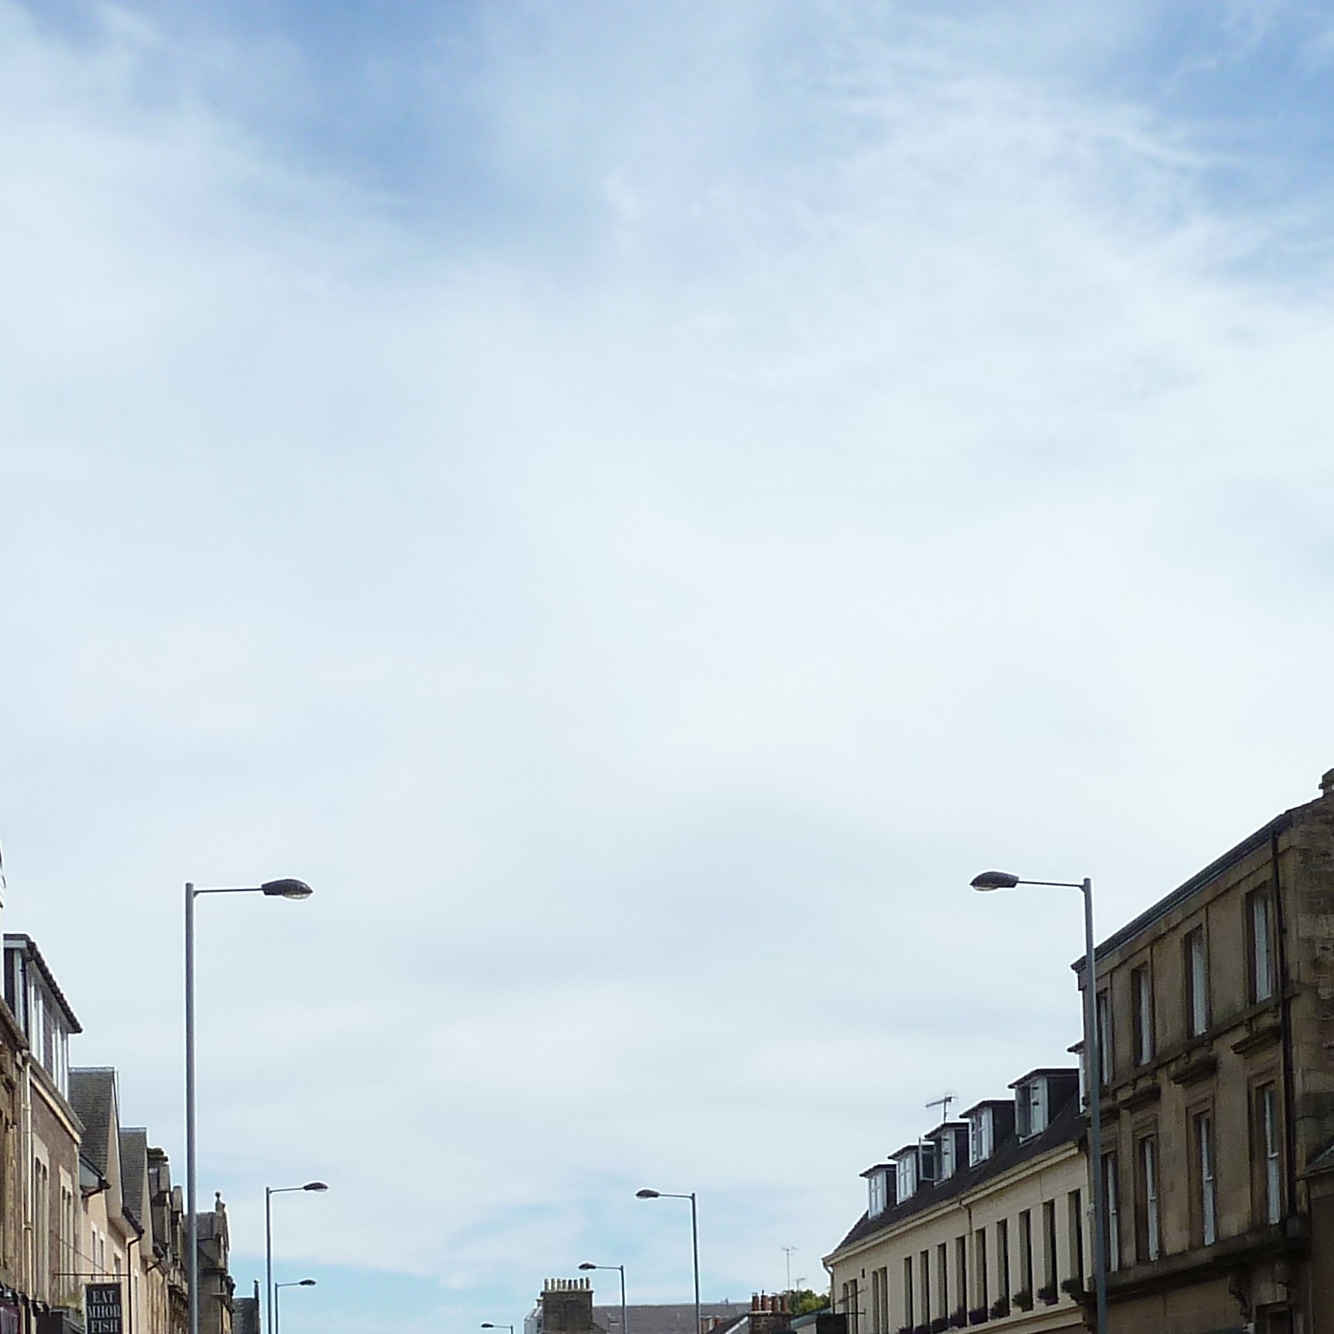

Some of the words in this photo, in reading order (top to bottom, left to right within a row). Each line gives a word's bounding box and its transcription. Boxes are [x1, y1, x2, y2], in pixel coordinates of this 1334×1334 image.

[92, 1290, 115, 1304] EAT
[88, 1305, 121, 1319] MHOR
[91, 1320, 119, 1334] FISH
